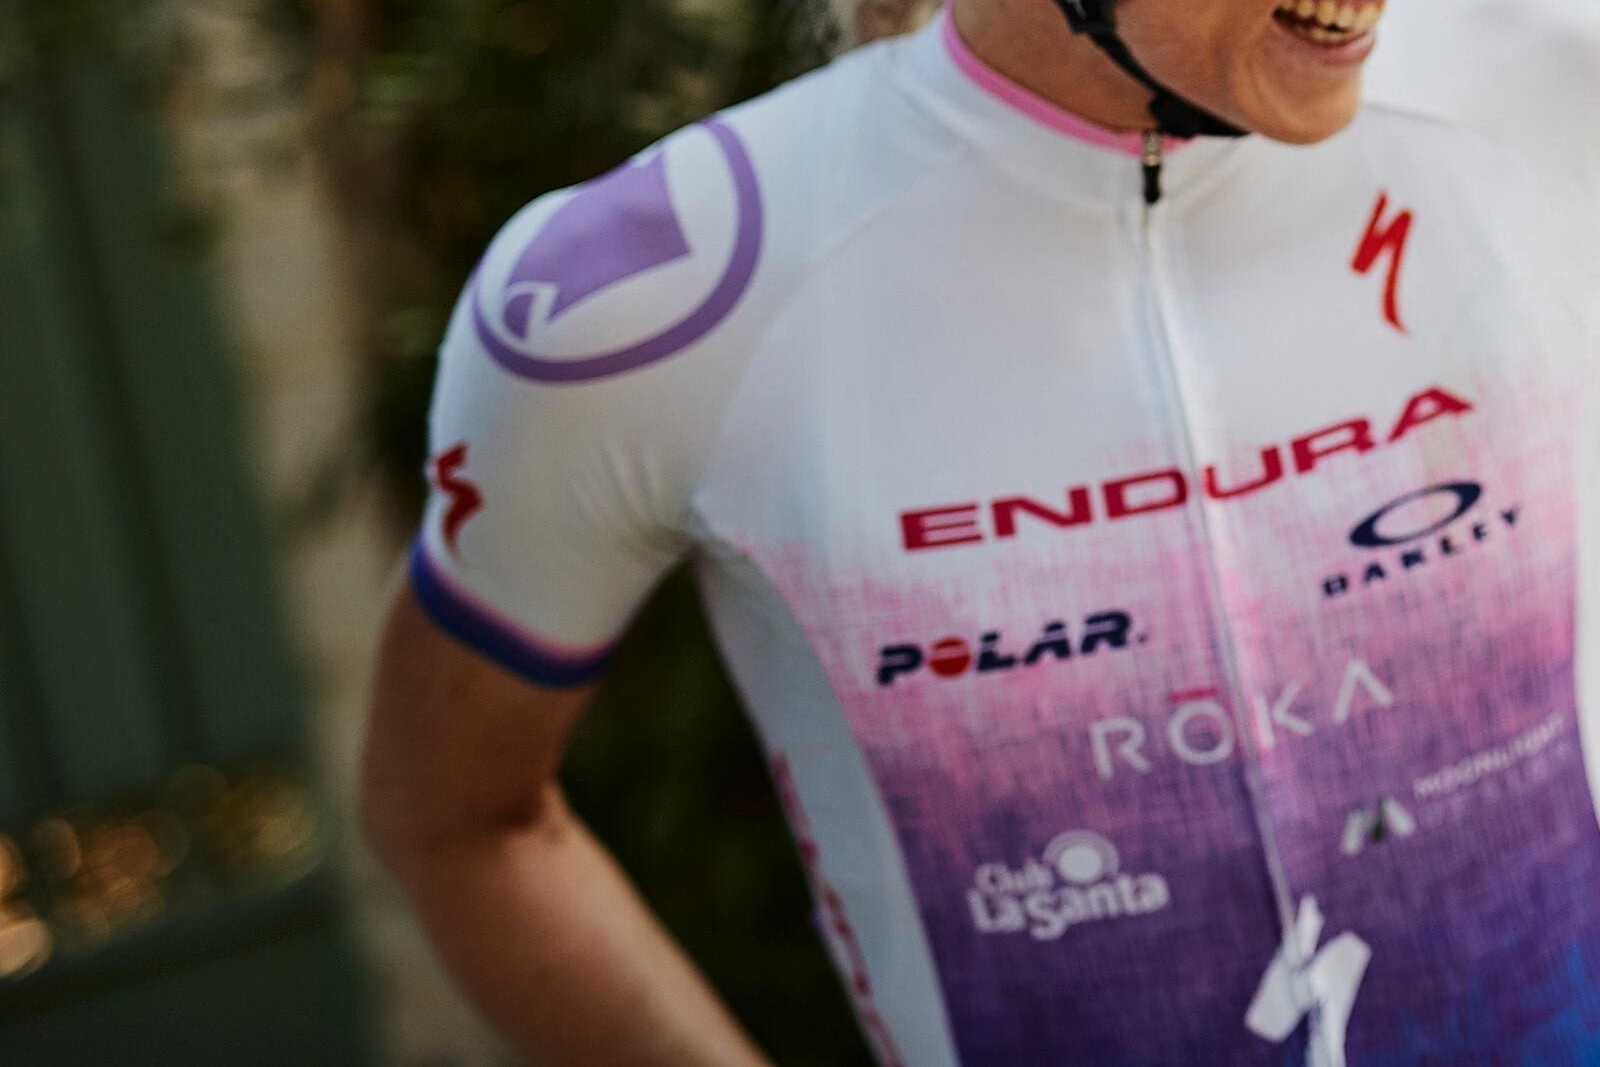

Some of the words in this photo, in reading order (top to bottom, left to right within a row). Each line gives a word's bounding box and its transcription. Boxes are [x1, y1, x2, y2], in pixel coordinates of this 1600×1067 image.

[898, 385, 1475, 551] ENDURA
[1321, 503, 1523, 598] OAKLEY
[876, 608, 1136, 686] POLAR
